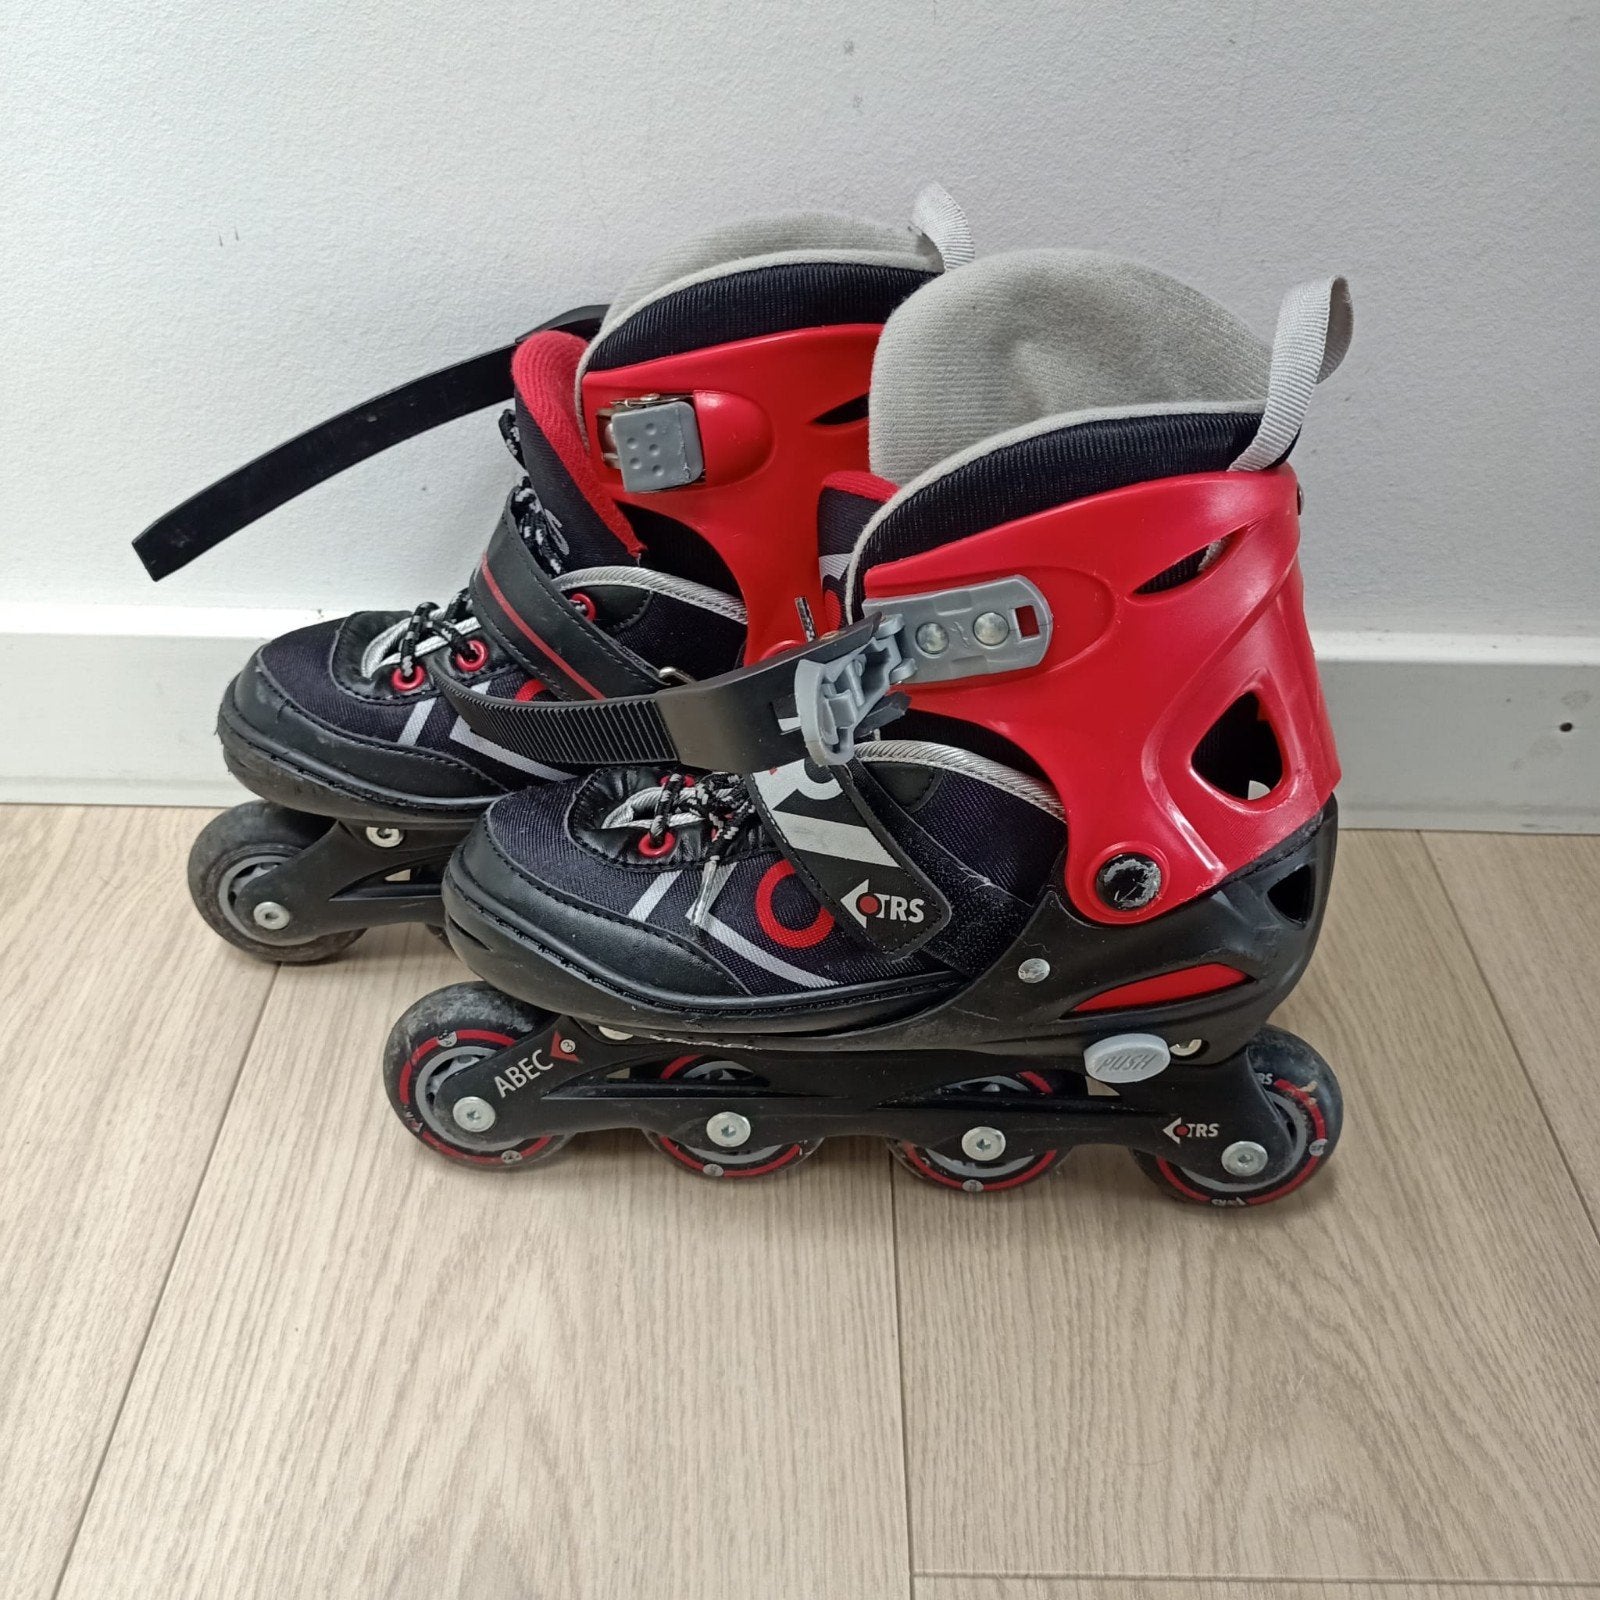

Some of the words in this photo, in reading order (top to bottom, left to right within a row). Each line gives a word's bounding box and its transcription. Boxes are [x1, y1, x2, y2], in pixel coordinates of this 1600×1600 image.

[873, 893, 925, 923] TRS
[1096, 1054, 1157, 1073] PUSH
[494, 1049, 554, 1098] ABEC
[1255, 1072, 1274, 1085] RS
[1185, 1123, 1220, 1138] TRS
